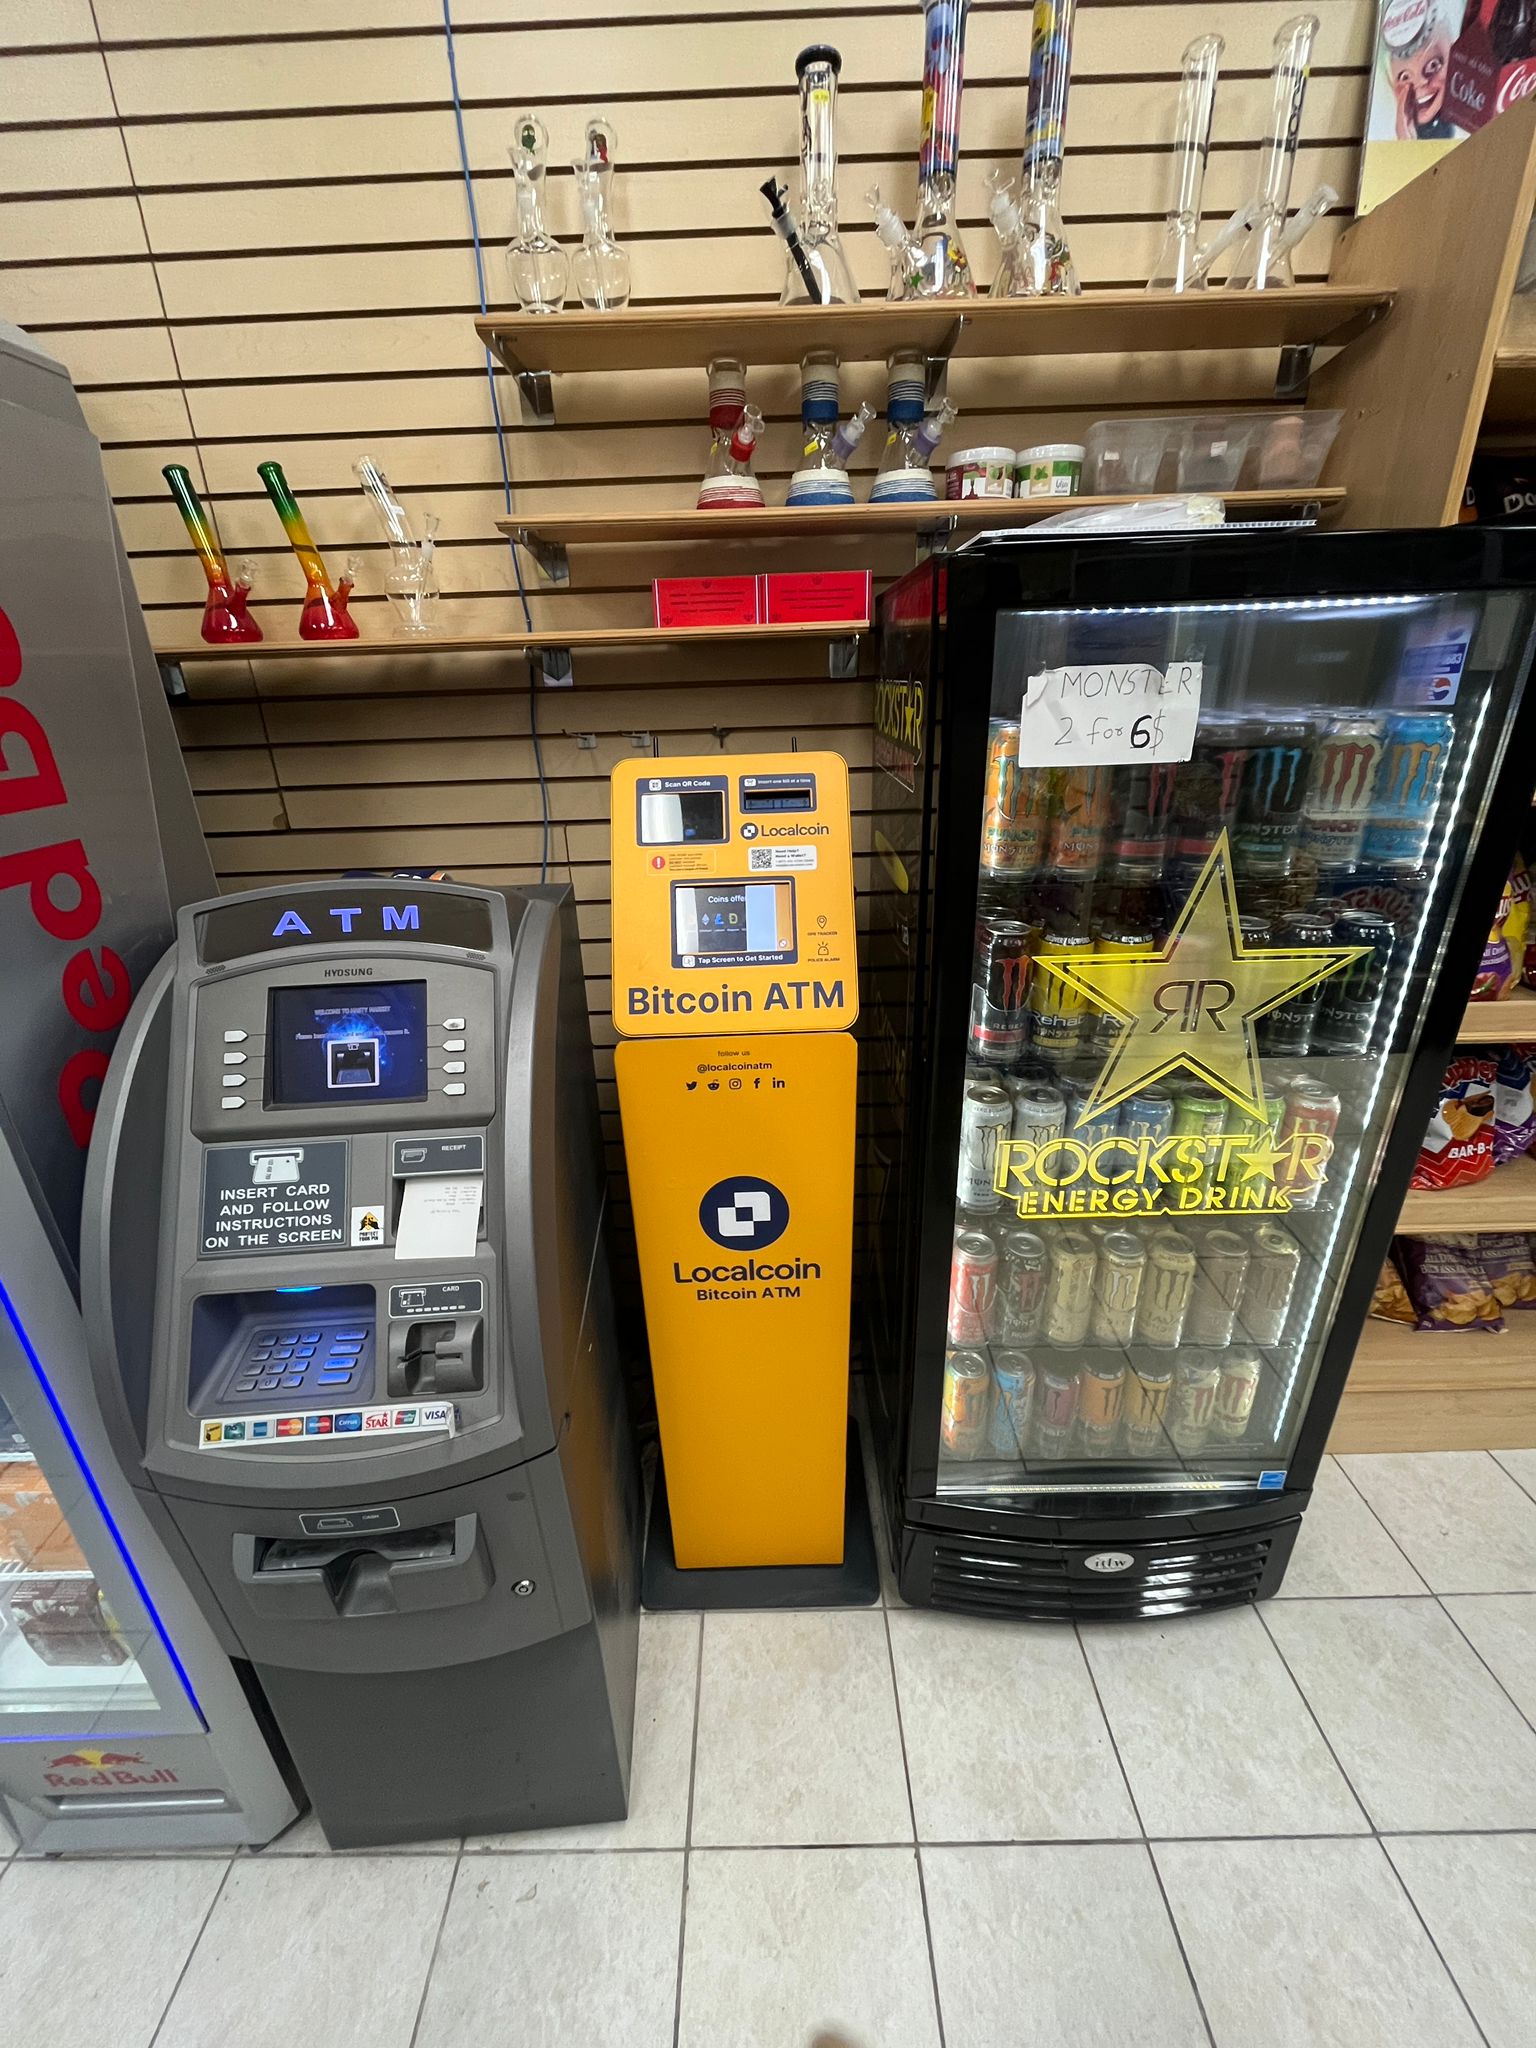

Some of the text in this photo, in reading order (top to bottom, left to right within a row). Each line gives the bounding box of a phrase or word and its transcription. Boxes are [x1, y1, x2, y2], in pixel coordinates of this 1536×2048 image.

[1450, 71, 1486, 111] Coke
[1061, 666, 1192, 698] MONSTER
[1054, 716, 1073, 746] 2
[1086, 716, 1124, 745] for
[761, 822, 829, 837] Localcoin
[707, 895, 729, 904] Coins
[272, 904, 420, 937] ATM
[698, 957, 710, 965] Tap
[324, 967, 373, 978] HYOSUNG
[628, 980, 844, 1016] Bitcoin ATM
[717, 1049, 740, 1058] follow
[697, 1061, 773, 1074] @localcoinatm
[220, 1183, 330, 1201] INSERT CARD
[1022, 1185, 1293, 1214] ENERGY DRINK
[219, 1199, 330, 1217] AND FOLLOW
[215, 1214, 332, 1232] INSTRUCTIONS
[205, 1229, 342, 1249] ON THE SCREEN
[673, 1257, 821, 1284] Localcoin
[696, 1286, 801, 1301] Bitcoin ATM
[338, 1419, 358, 1427] Cirrus
[365, 1418, 389, 1429] STAR
[424, 1410, 447, 1420] VISA
[43, 1768, 179, 1788] Red Bull
